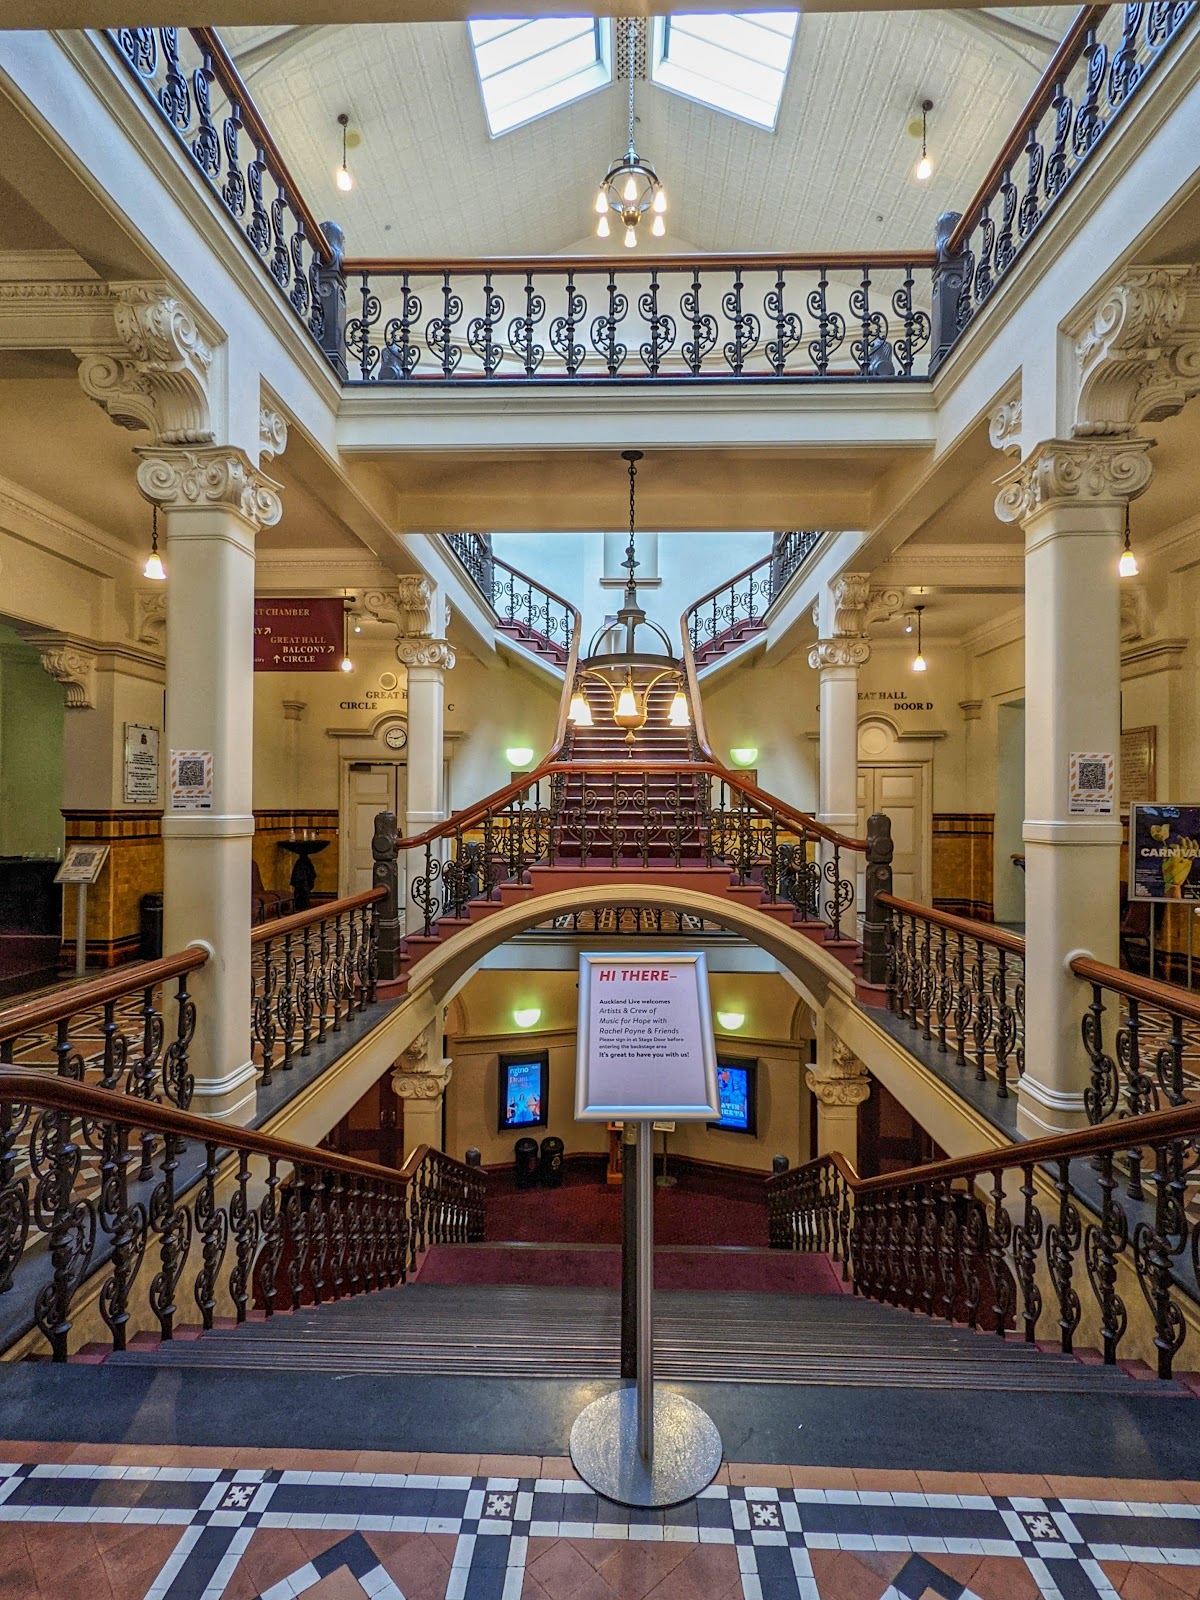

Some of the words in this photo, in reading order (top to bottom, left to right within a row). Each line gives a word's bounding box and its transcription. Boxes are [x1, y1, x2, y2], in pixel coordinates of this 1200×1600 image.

[265, 608, 310, 616] CHAMBER
[270, 636, 300, 644] GREAT
[302, 636, 326, 644] HALL
[282, 655, 315, 663] CIRCLE
[366, 691, 400, 699] GREAT
[857, 692, 877, 700] EAT
[879, 692, 907, 700] HALL
[893, 702, 924, 710] DOOR
[926, 702, 933, 710] D
[600, 970, 616, 981] HI
[720, 1102, 740, 1110] ATIN
[721, 1109, 744, 1117] IESTA
